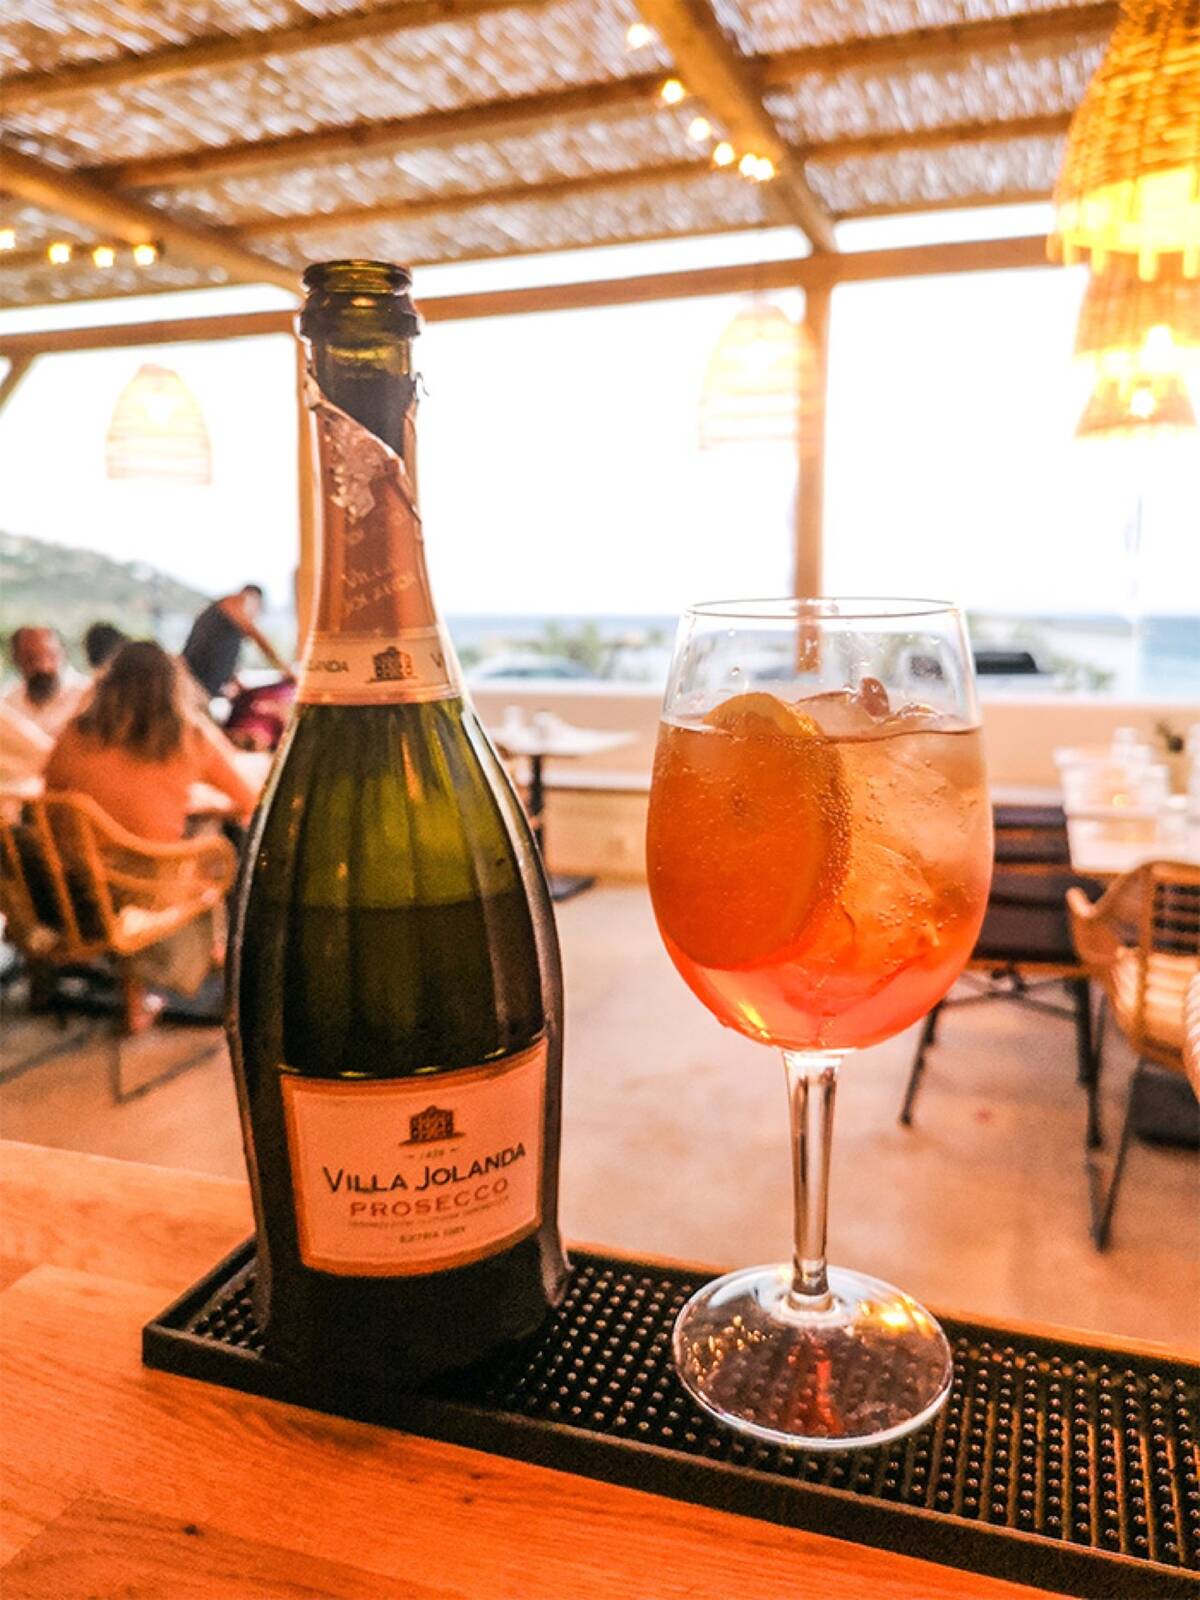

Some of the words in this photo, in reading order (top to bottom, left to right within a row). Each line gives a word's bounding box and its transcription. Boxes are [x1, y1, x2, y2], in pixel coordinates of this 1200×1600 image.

[322, 1166, 407, 1194] VILLA
[415, 1142, 527, 1192] JOLANDA
[349, 1177, 508, 1217] PROSECCO
